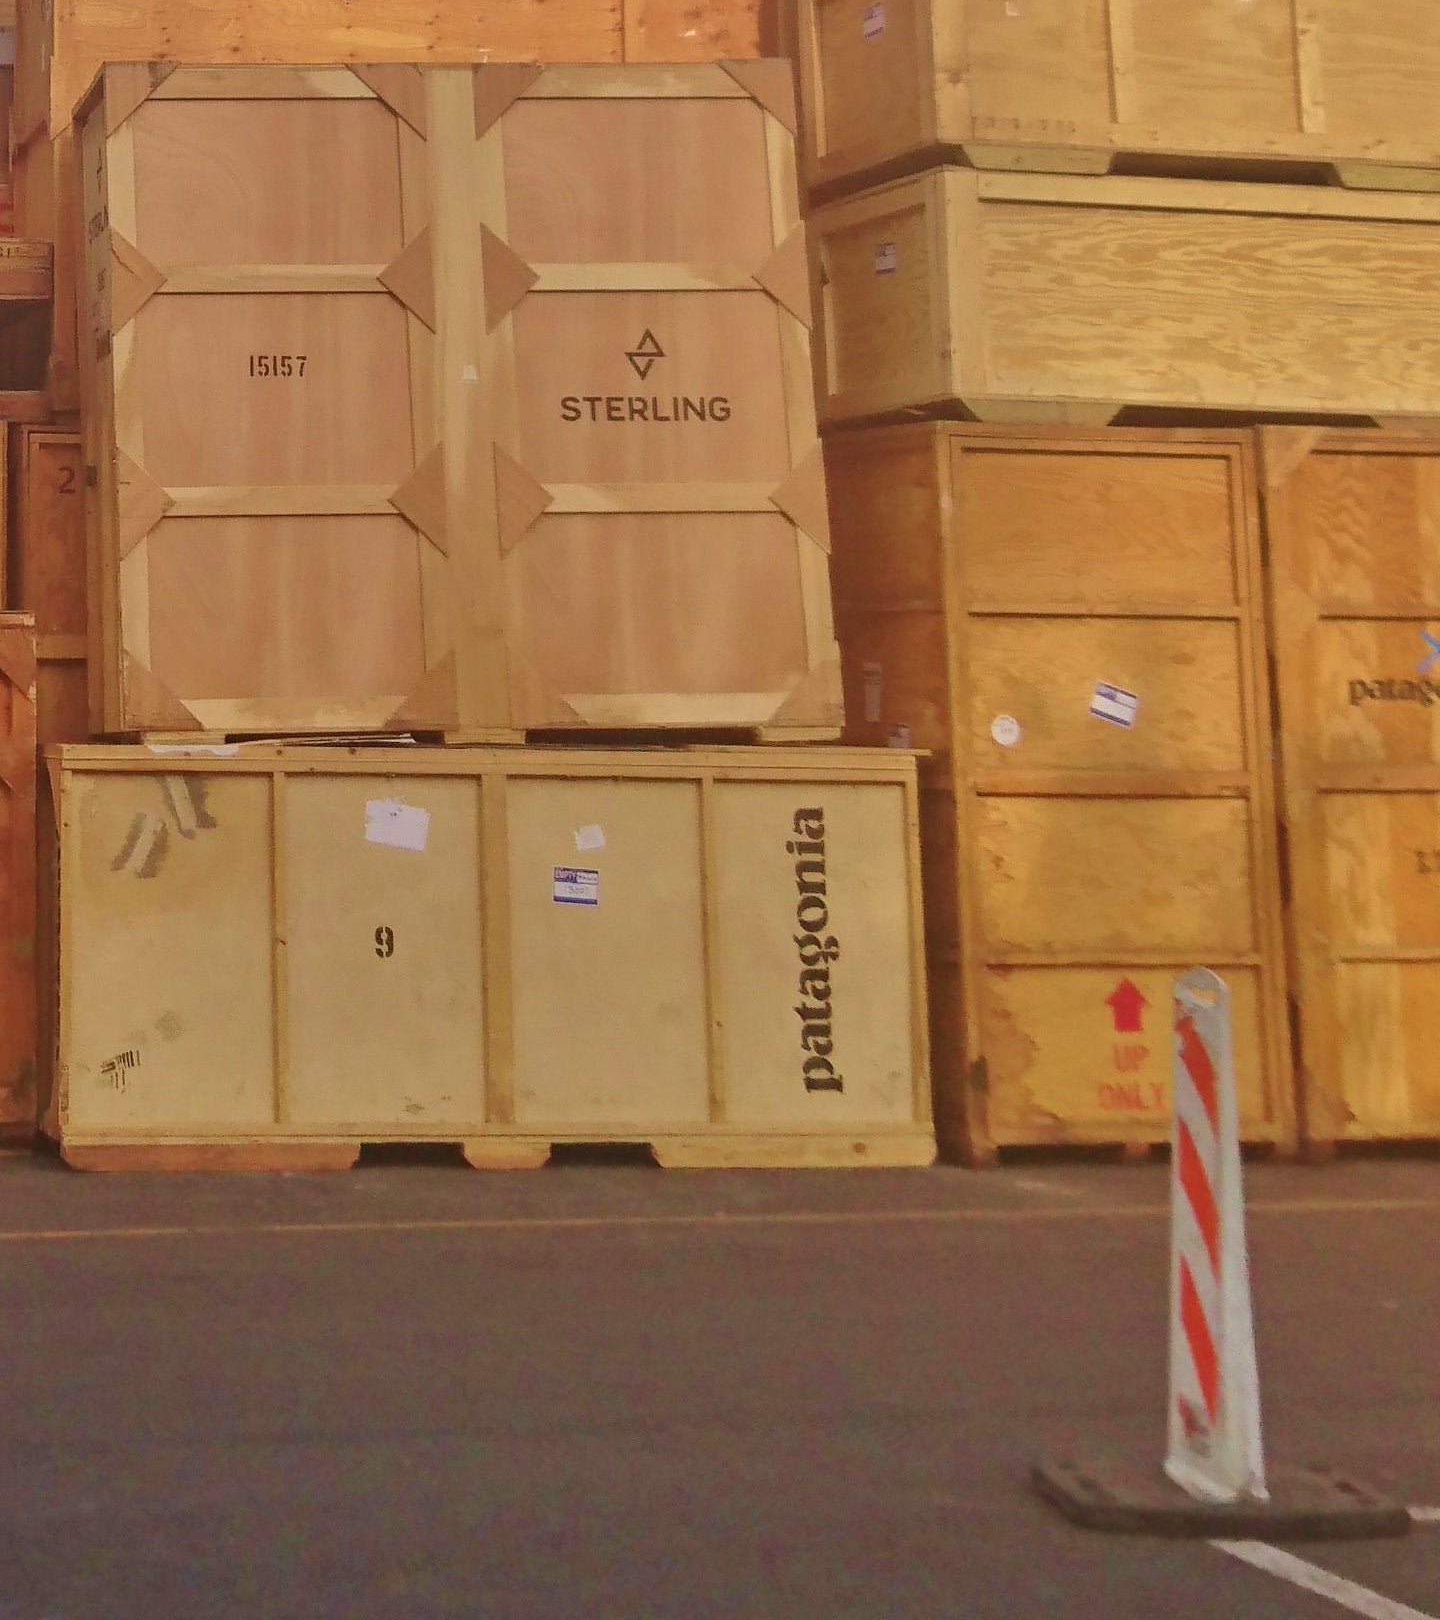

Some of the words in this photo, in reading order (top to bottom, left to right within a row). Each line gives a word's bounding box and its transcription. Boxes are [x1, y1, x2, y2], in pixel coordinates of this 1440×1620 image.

[249, 355, 308, 378] 15157
[560, 395, 732, 423] STERLING
[374, 926, 395, 958] 9
[786, 806, 844, 1094] patagonia
[1113, 1044, 1150, 1072] UP
[1097, 1083, 1165, 1111] ONLY
